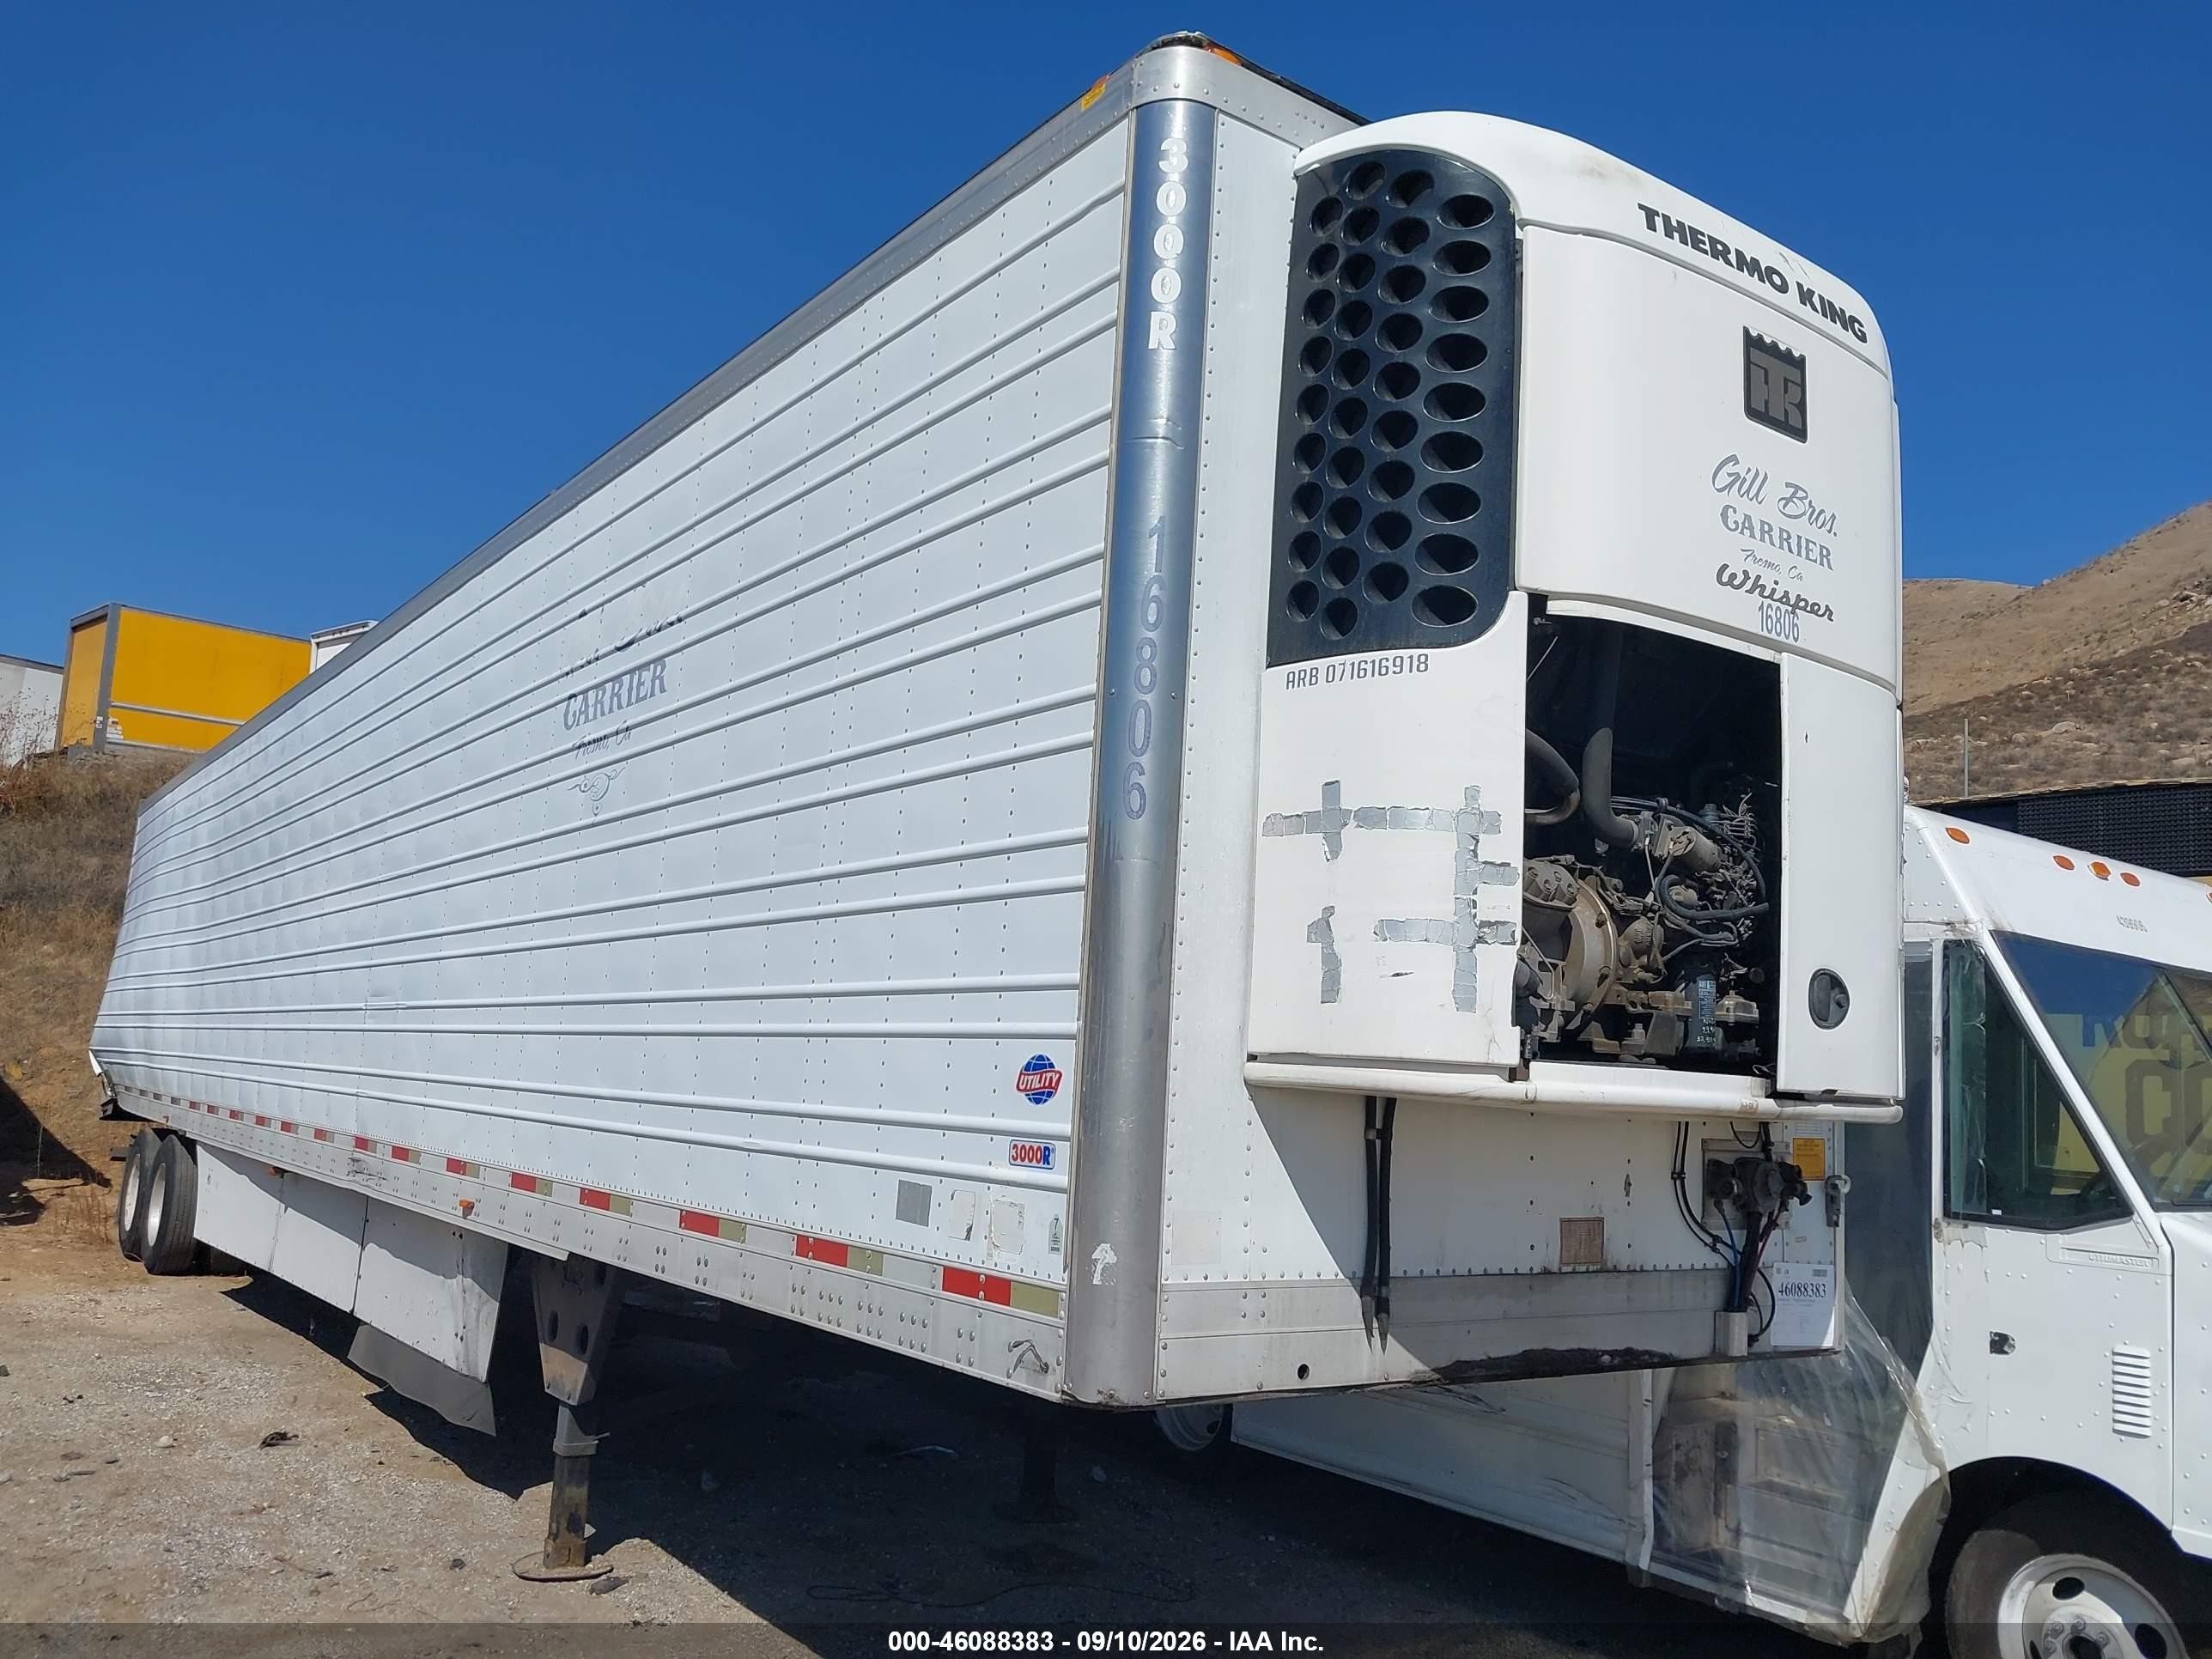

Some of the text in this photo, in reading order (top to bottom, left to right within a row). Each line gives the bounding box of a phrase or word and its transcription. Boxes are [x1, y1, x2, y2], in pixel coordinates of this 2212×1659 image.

[1148, 137, 1188, 349] 3000R
[1637, 202, 1868, 344] THERMO KING
[1711, 453, 1838, 538] Gill Bros.
[1720, 504, 1834, 571] CARRIER
[1716, 563, 1834, 623] Whisper
[1758, 600, 1800, 643] 16806
[563, 658, 667, 731] CARRIER
[1122, 515, 1166, 820] 16806
[1285, 653, 1430, 690] ARB 071616918
[1018, 1072, 1060, 1090] UTILITY
[1778, 1281, 1827, 1298] 46088383
